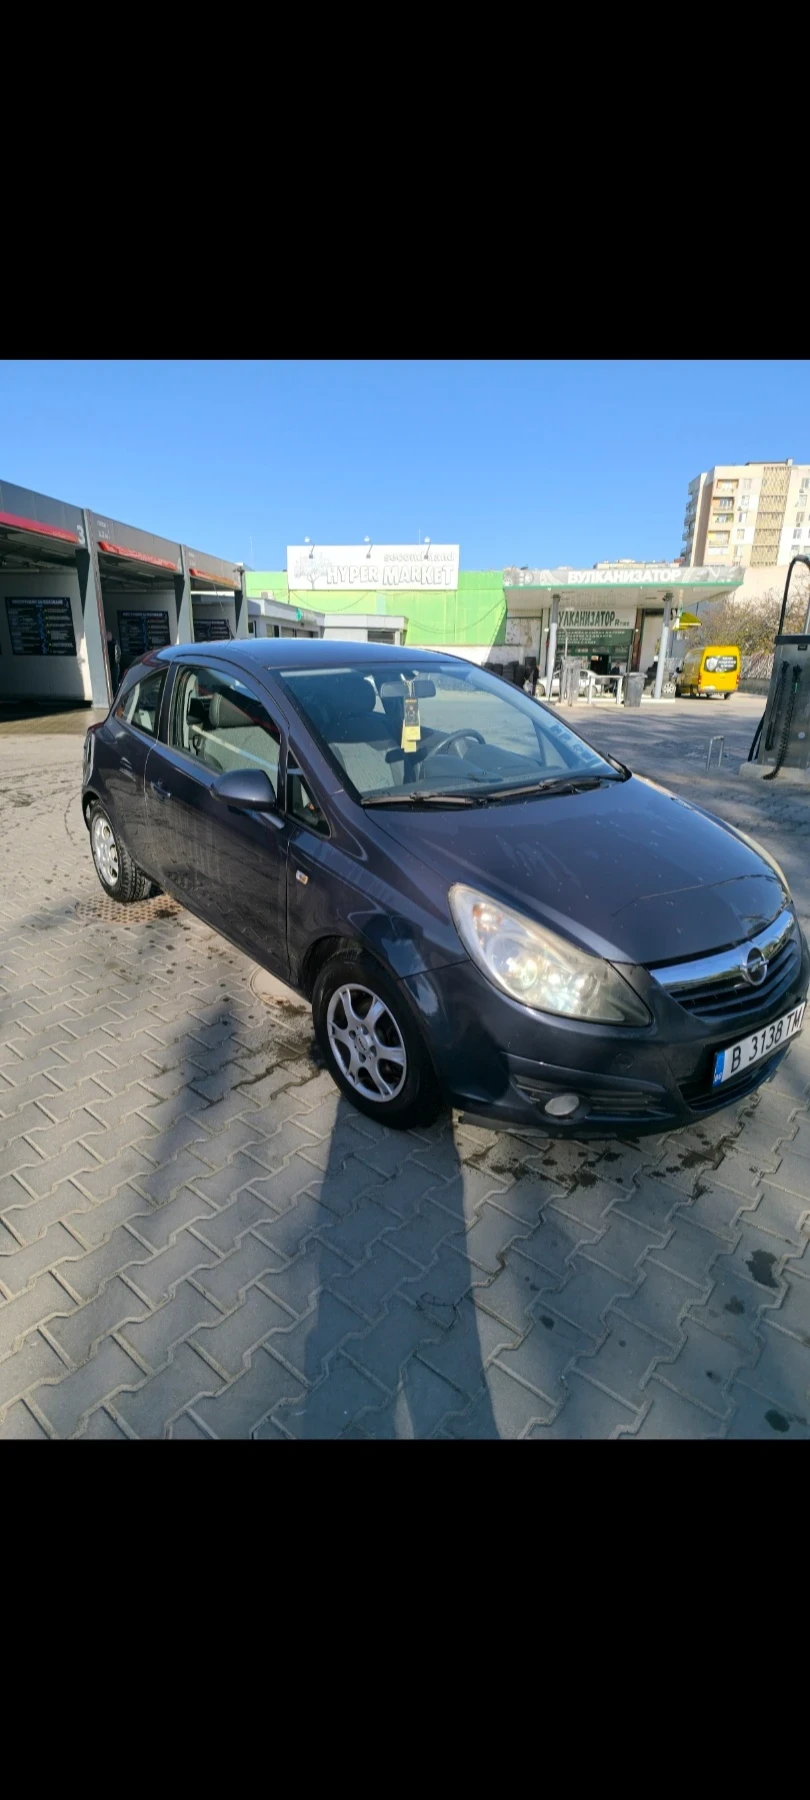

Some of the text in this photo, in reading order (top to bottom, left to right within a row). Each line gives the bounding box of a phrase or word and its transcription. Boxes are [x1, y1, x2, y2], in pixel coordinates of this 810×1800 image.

[77, 524, 86, 545] 3
[384, 551, 424, 562] second
[327, 565, 454, 586] HYPER MARKET
[567, 569, 682, 584] ВУЛКАНИЗАТОР
[558, 610, 615, 627] УЛКАНИЗАТОР
[731, 1006, 804, 1074] B 3138 TM
